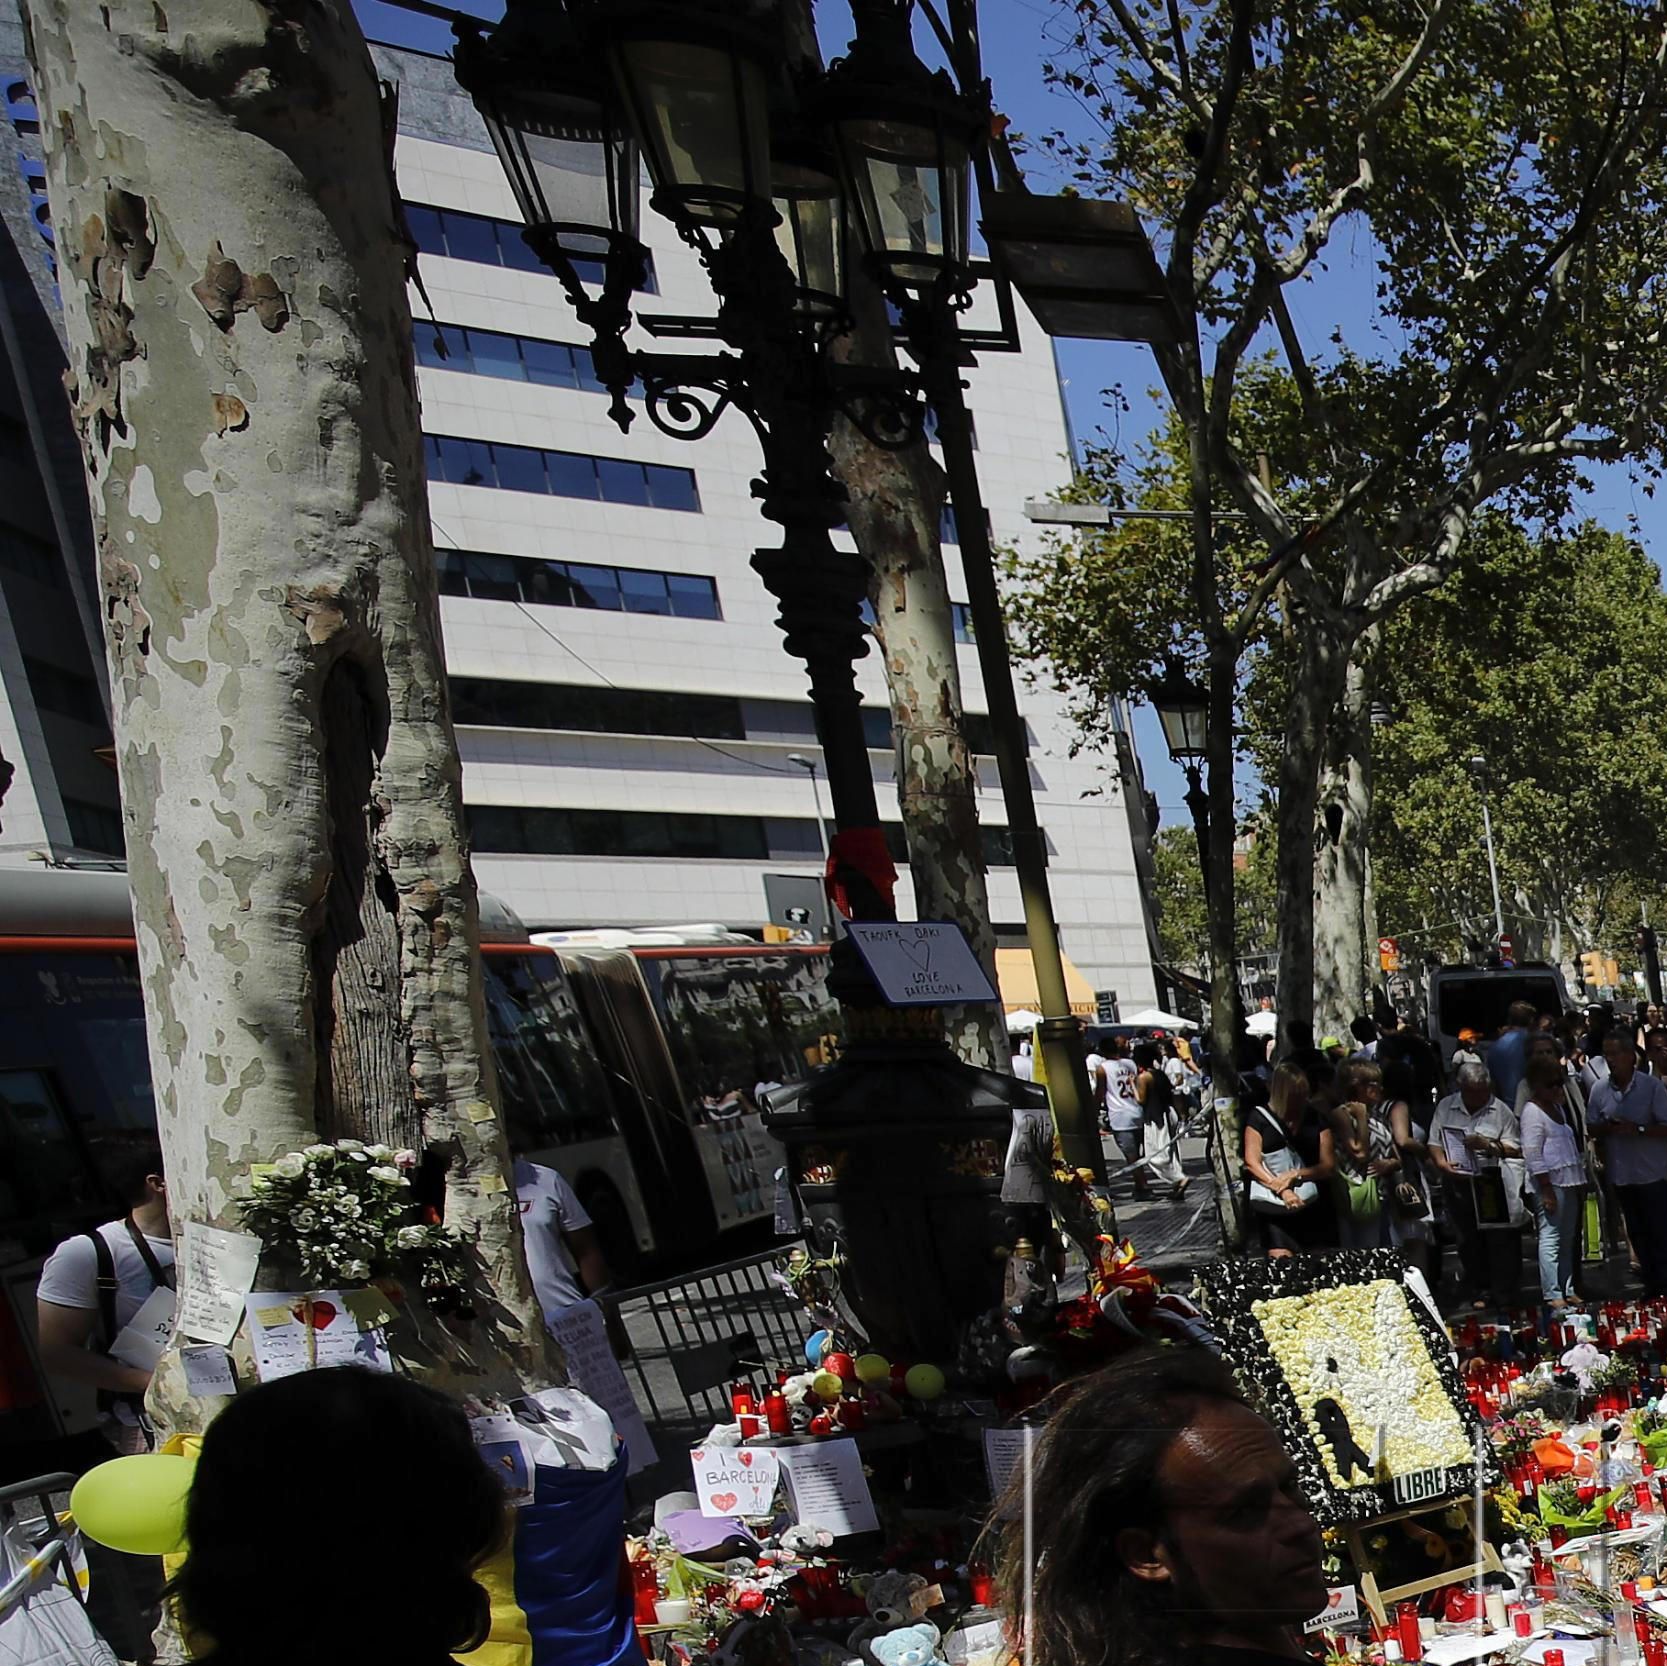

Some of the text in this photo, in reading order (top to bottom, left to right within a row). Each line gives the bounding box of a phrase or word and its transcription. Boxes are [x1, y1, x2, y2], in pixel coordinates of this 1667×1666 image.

[912, 971, 940, 983] LOVE
[904, 984, 965, 997] BARCELONA
[1395, 1468, 1444, 1502] LIBRE
[1305, 1609, 1357, 1629] BARCELONA
